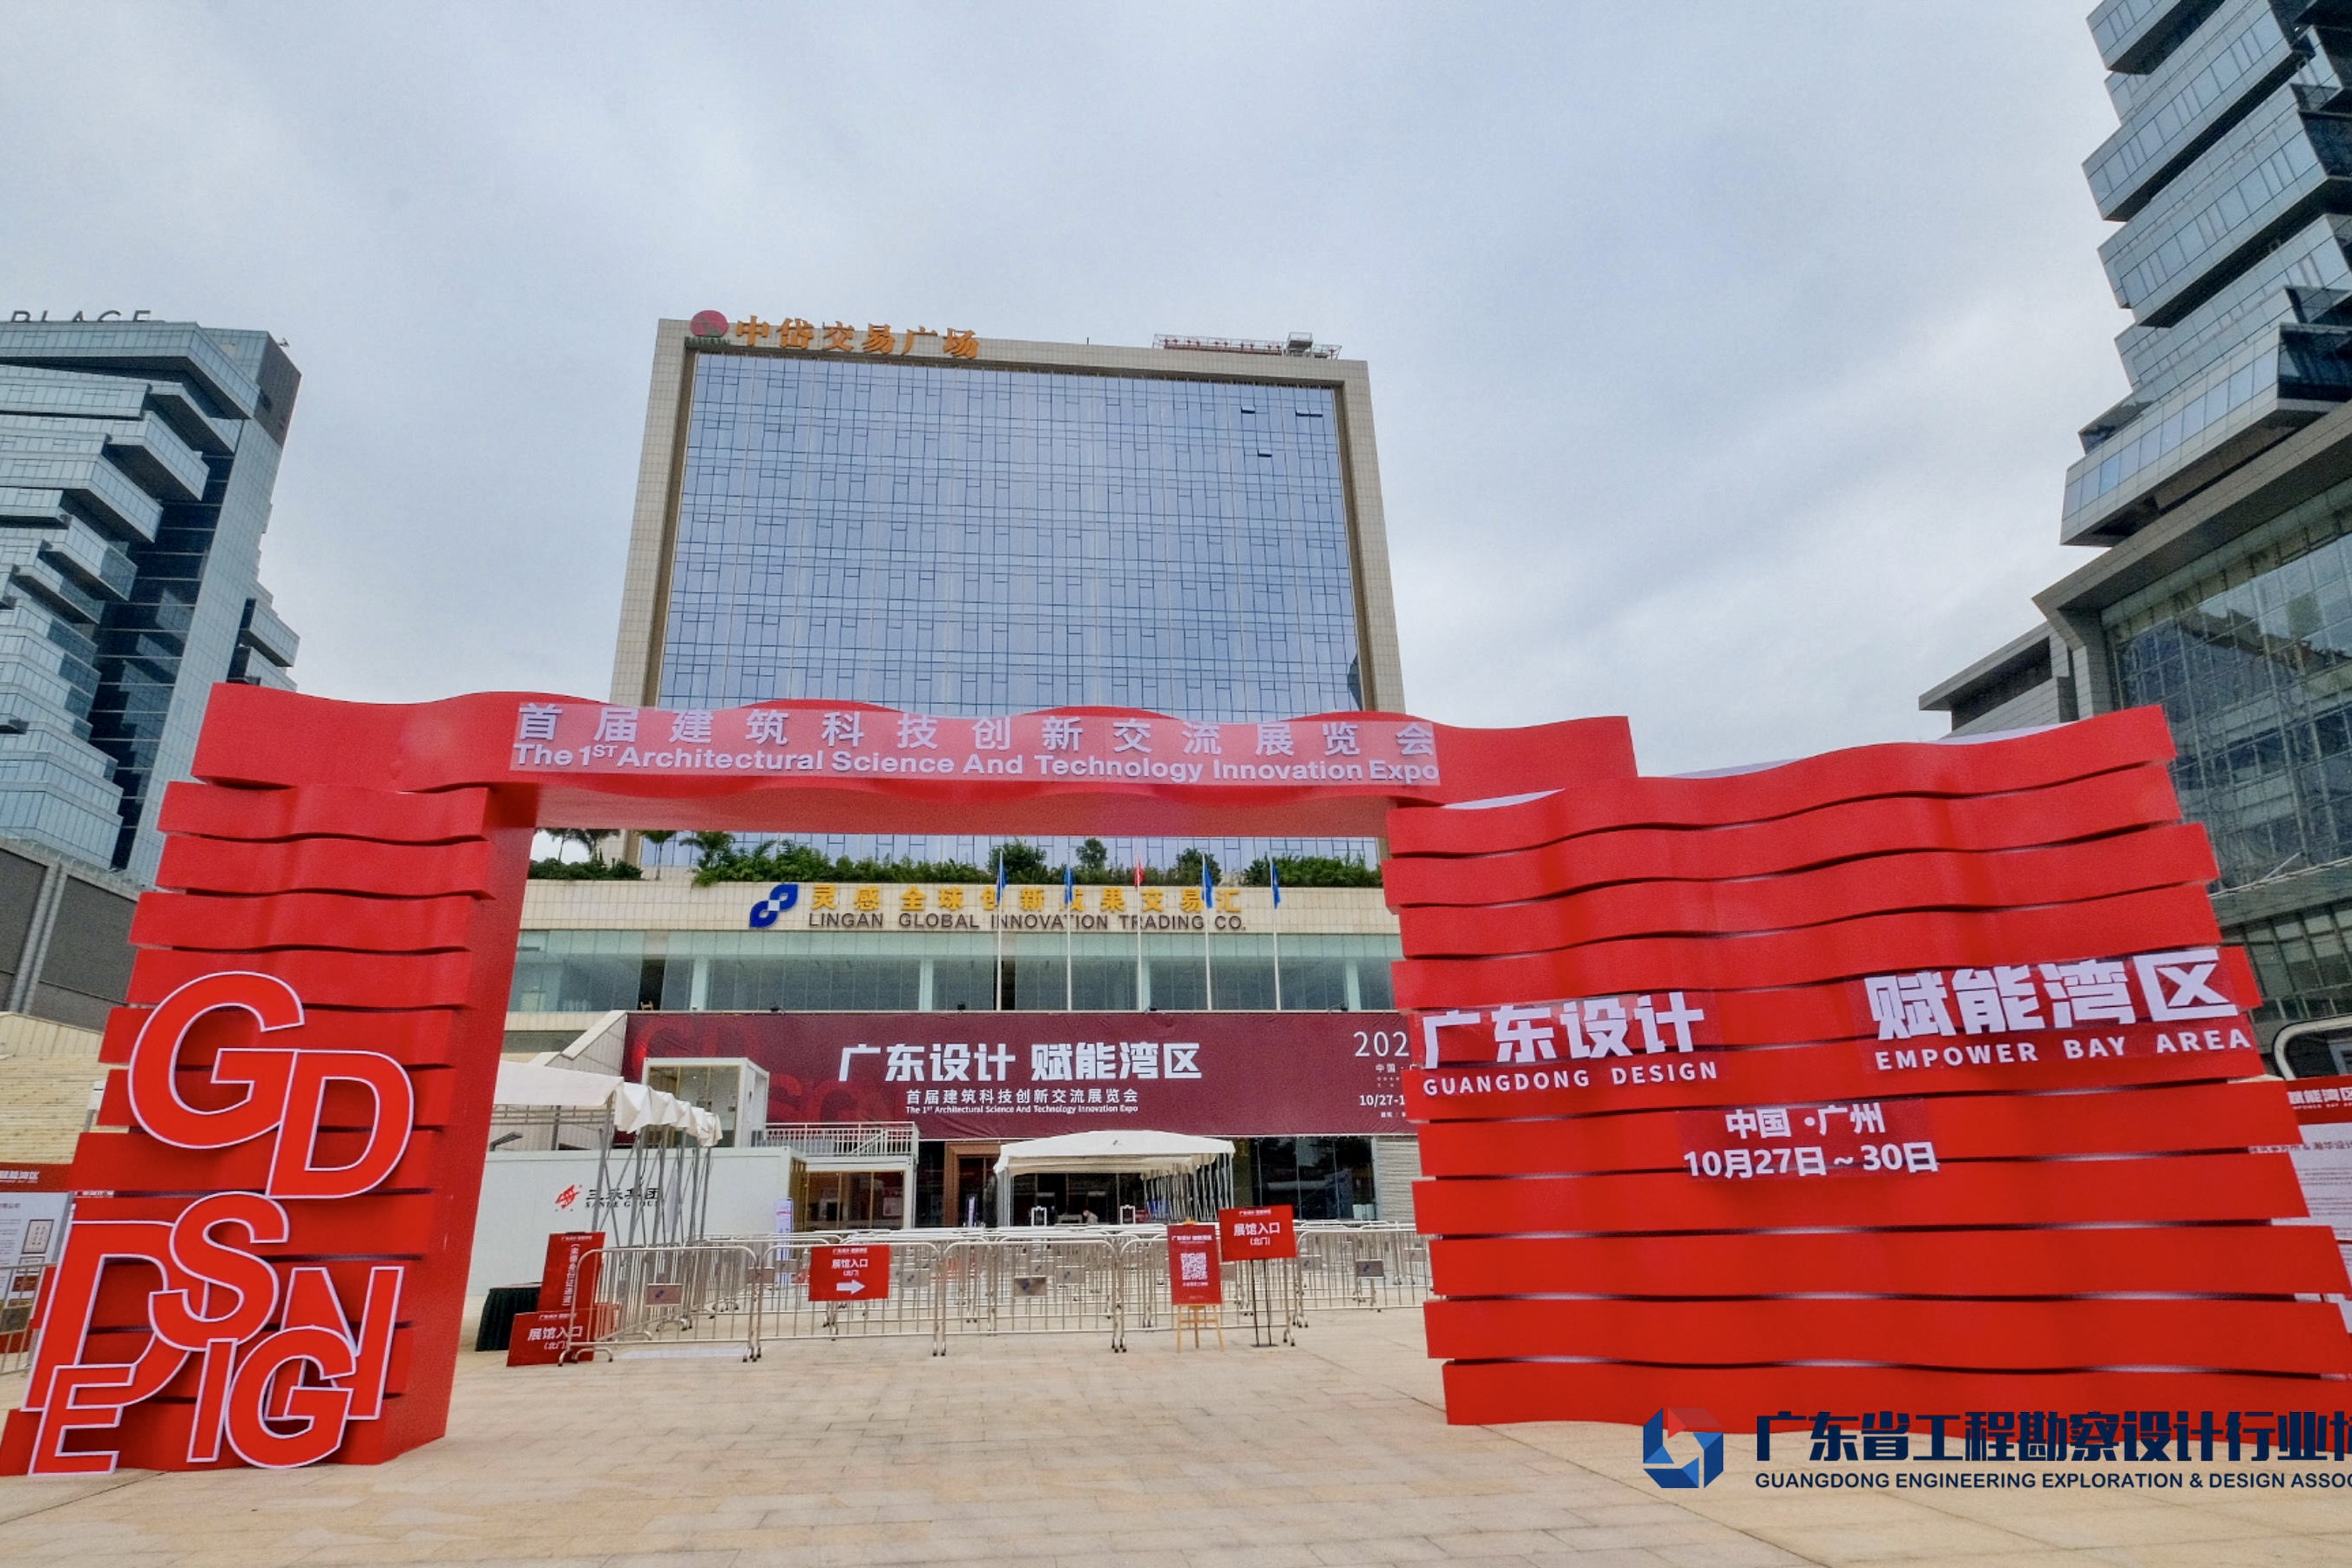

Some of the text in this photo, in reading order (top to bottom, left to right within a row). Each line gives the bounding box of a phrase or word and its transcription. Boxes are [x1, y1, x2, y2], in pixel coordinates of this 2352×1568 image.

[735, 314, 980, 359] 中岱交易广场
[518, 702, 1436, 756] 首届建筑科技创新交流展览会
[513, 743, 571, 767] The
[618, 747, 823, 772] Architectural
[831, 750, 954, 774] Science
[963, 754, 1024, 775] And
[1034, 754, 1203, 783] Technology
[1213, 757, 1365, 781] Innovation
[1369, 760, 1440, 785] Expo
[808, 913, 883, 929] LINGAN
[898, 913, 980, 929] GLOBAL
[1119, 915, 1205, 930] TRADING
[1214, 916, 1247, 931] CO.
[1865, 948, 2240, 1041] 赋能湾区
[1423, 990, 1705, 1070] 广东设计
[1876, 1028, 2251, 1071] EMPOWER BAY AREA
[838, 1042, 1202, 1083] 广东设计 赋能湾区
[1423, 1069, 1590, 1096] GUANGDONG
[1612, 1061, 1717, 1085] DESIGN
[905, 1088, 1139, 1105] 首届建筑科技创新交流展览会
[906, 1105, 921, 1114] The
[935, 1105, 983, 1113] Architectural
[985, 1105, 1014, 1113] Science
[1016, 1105, 1031, 1113] And
[1033, 1104, 1077, 1114] Technology
[1078, 1104, 1119, 1113] Innovation
[1120, 1104, 1139, 1114] Expo
